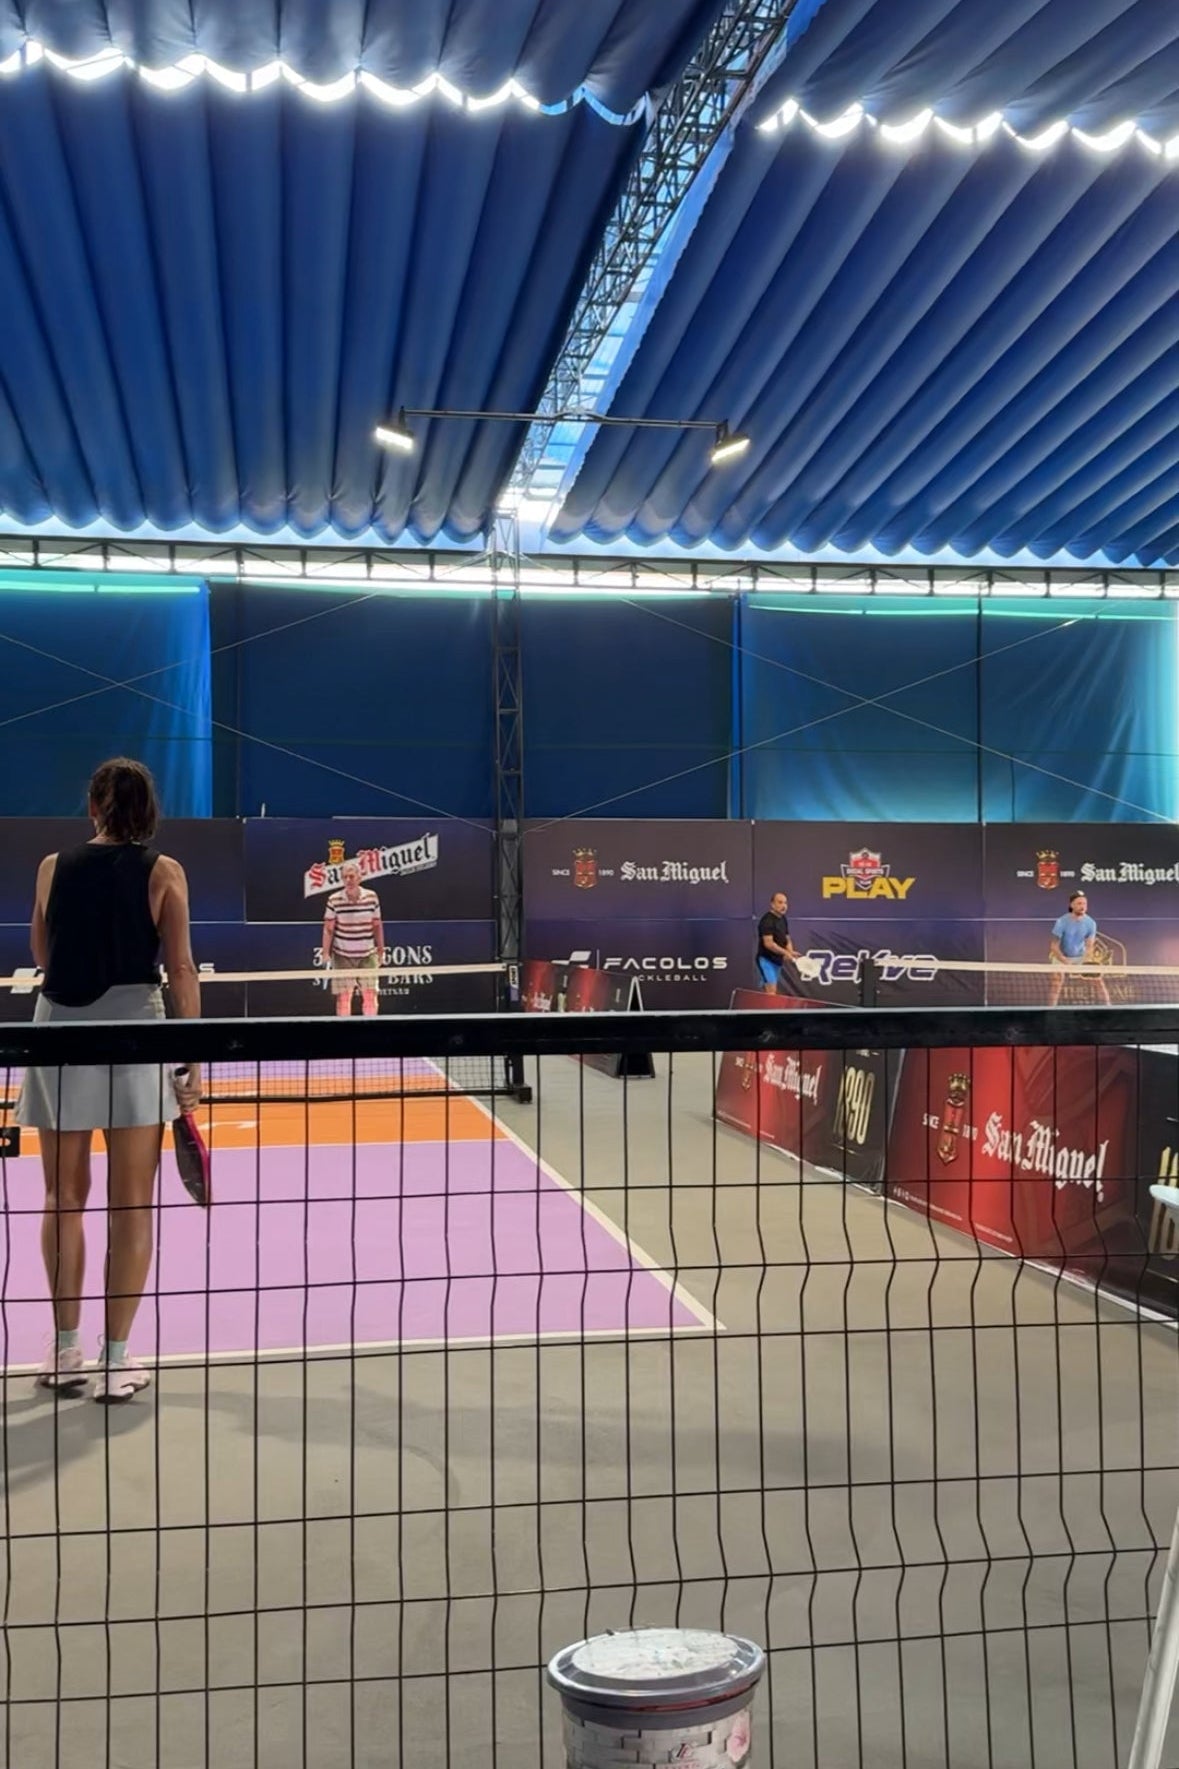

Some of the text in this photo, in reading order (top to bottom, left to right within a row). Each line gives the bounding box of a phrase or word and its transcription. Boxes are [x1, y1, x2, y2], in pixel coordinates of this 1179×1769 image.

[357, 833, 431, 876] Miguel
[620, 861, 729, 884] San Miguel
[1080, 862, 1116, 882] San
[822, 877, 915, 899] PLAY
[603, 957, 728, 970] FACOLOS
[982, 1112, 1109, 1201] San Miguel
